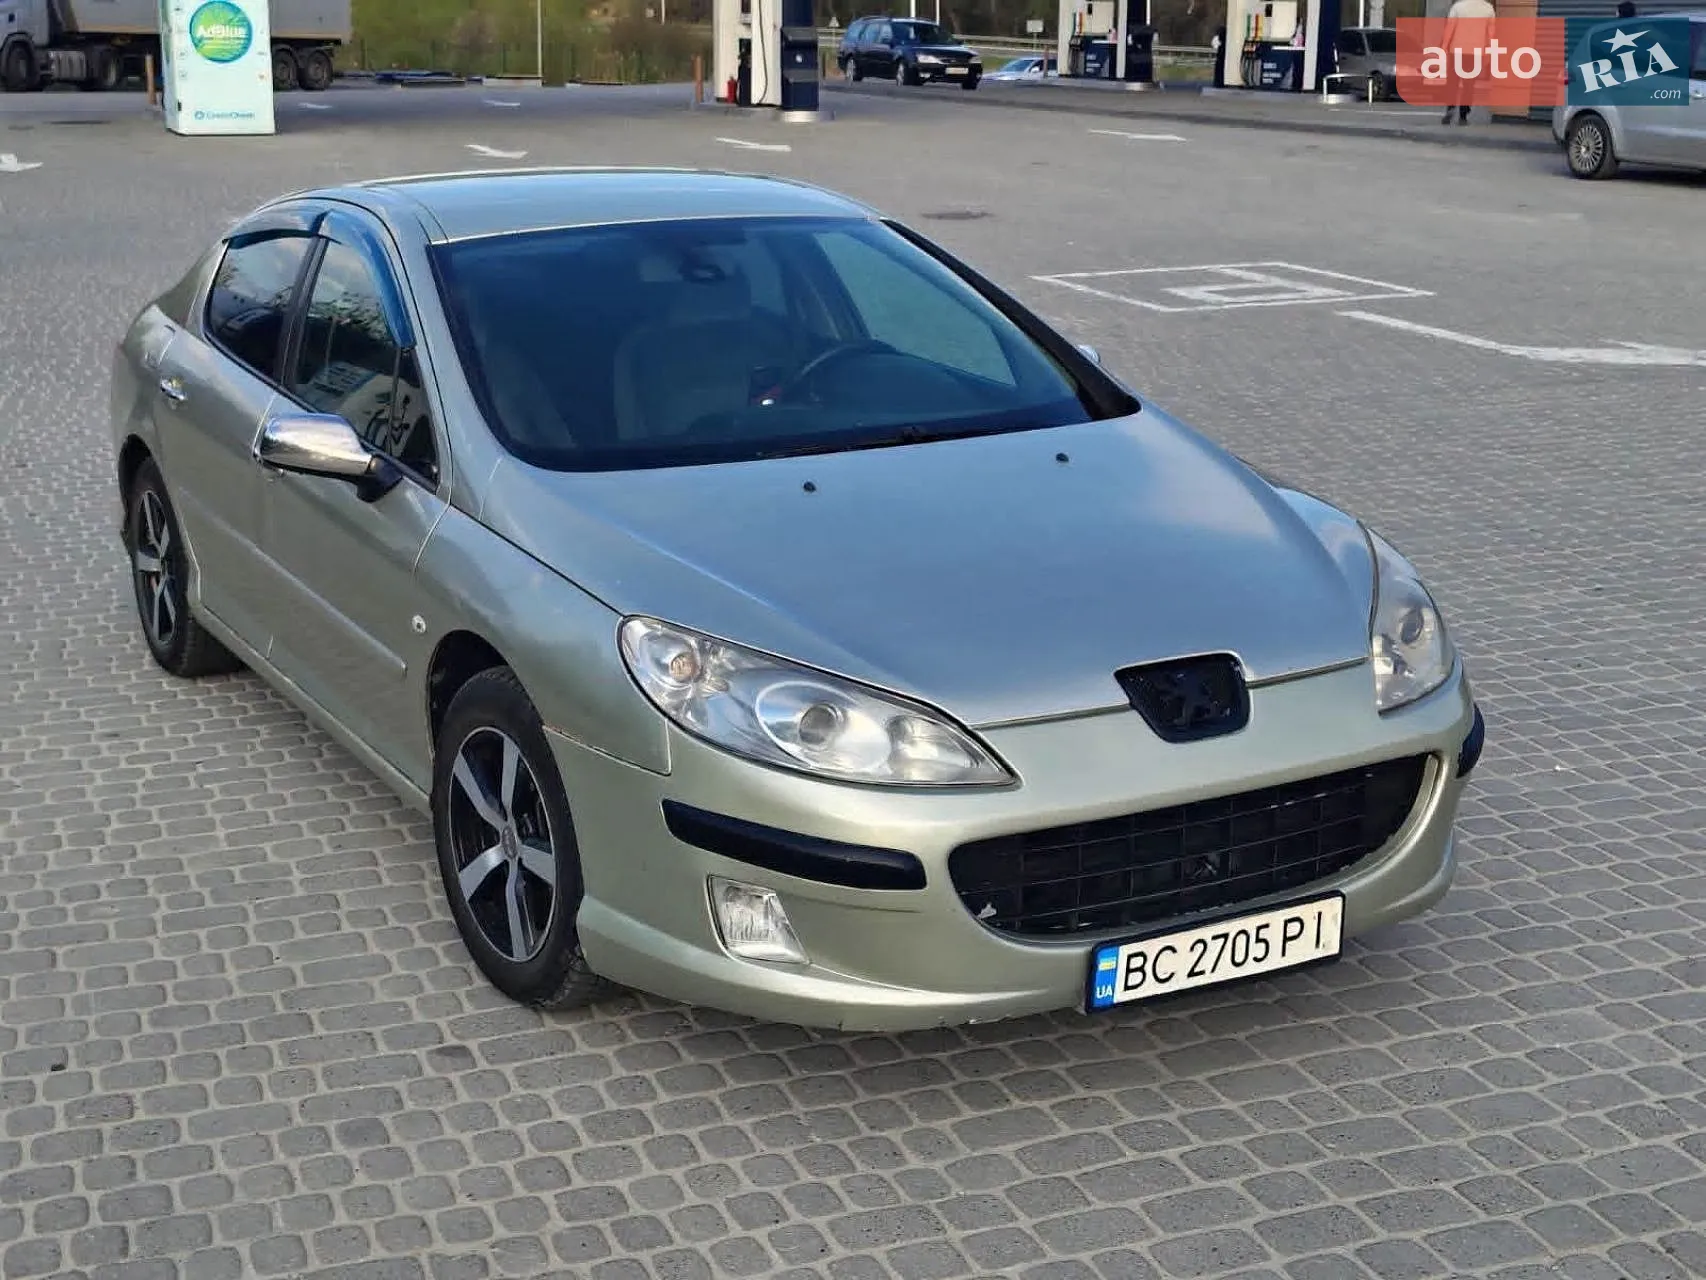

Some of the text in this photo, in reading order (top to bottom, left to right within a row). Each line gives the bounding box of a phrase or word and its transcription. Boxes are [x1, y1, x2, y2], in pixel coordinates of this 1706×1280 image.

[1123, 945, 1177, 992] BC
[1187, 923, 1270, 979] 2705
[1096, 984, 1113, 999] UA
